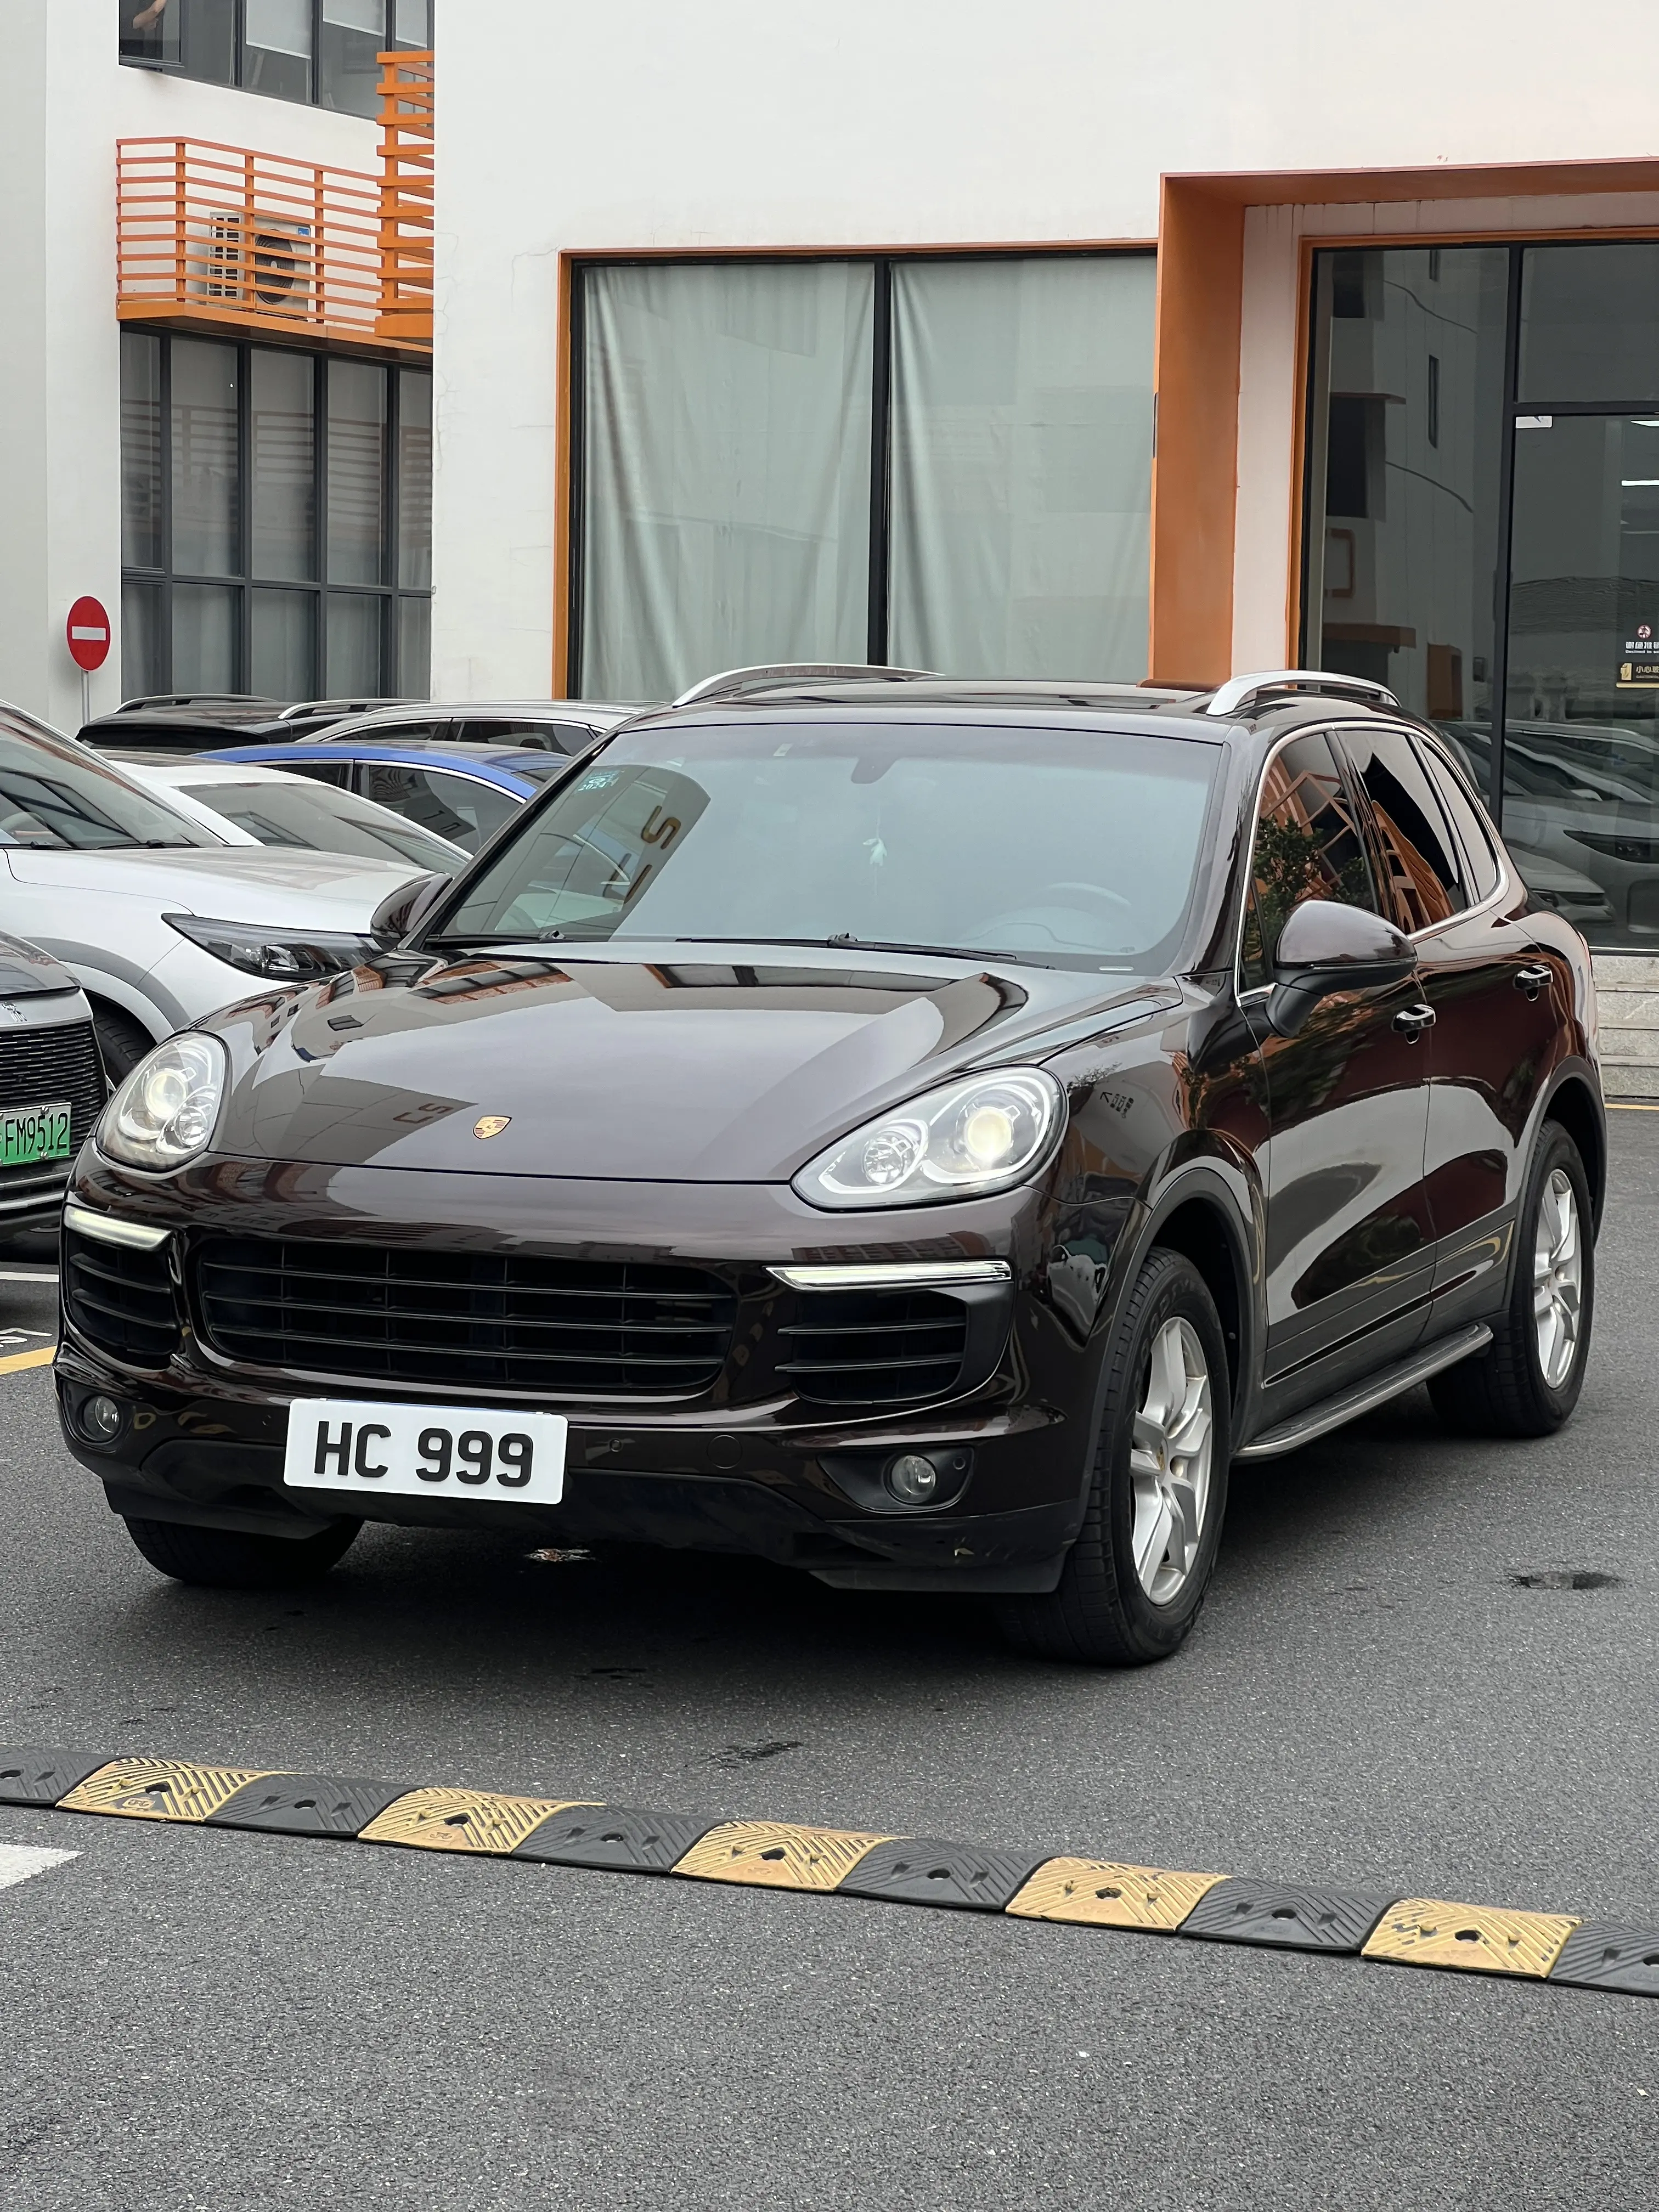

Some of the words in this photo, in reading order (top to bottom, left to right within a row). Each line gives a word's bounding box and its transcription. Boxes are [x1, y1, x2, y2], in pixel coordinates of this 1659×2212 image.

[5, 1112, 68, 1157] FM9512
[314, 1420, 392, 1479] HC
[415, 1427, 534, 1488] 999
